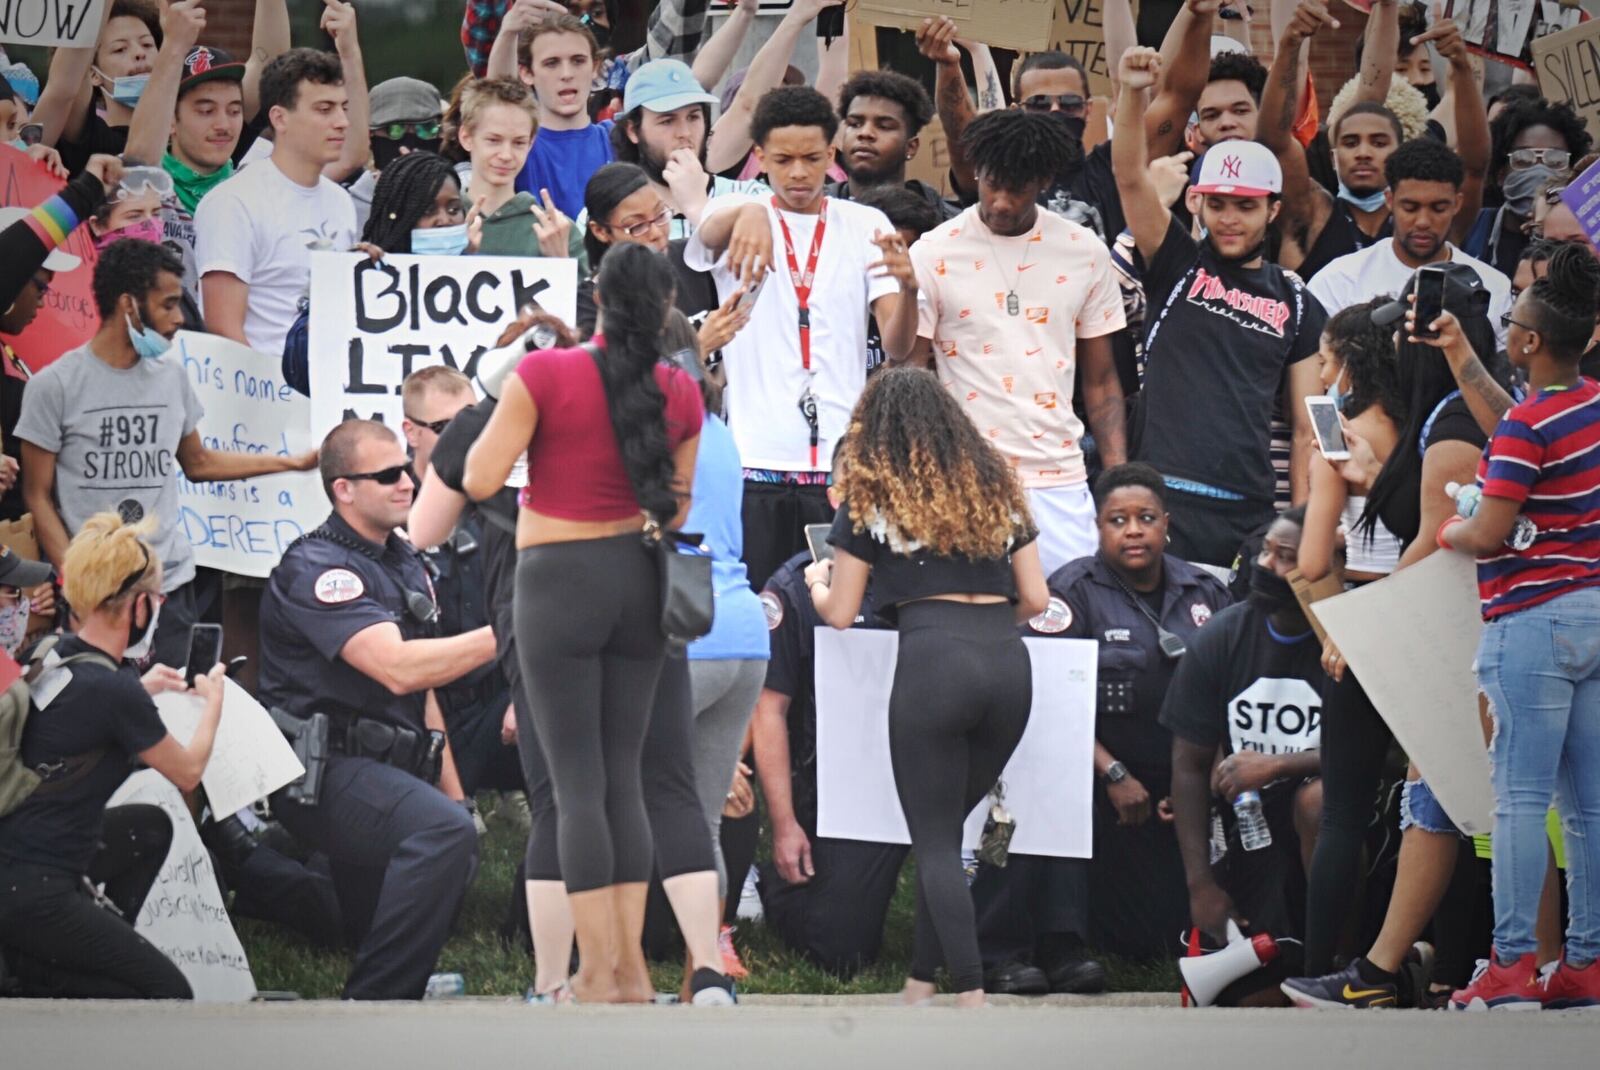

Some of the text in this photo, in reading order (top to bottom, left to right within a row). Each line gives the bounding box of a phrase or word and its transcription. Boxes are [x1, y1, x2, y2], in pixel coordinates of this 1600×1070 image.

[235, 369, 292, 402] name
[100, 414, 158, 447] #937
[84, 449, 171, 479] STRONG
[277, 490, 293, 507] a
[176, 505, 304, 556] DERED
[1235, 699, 1321, 737] STOP
